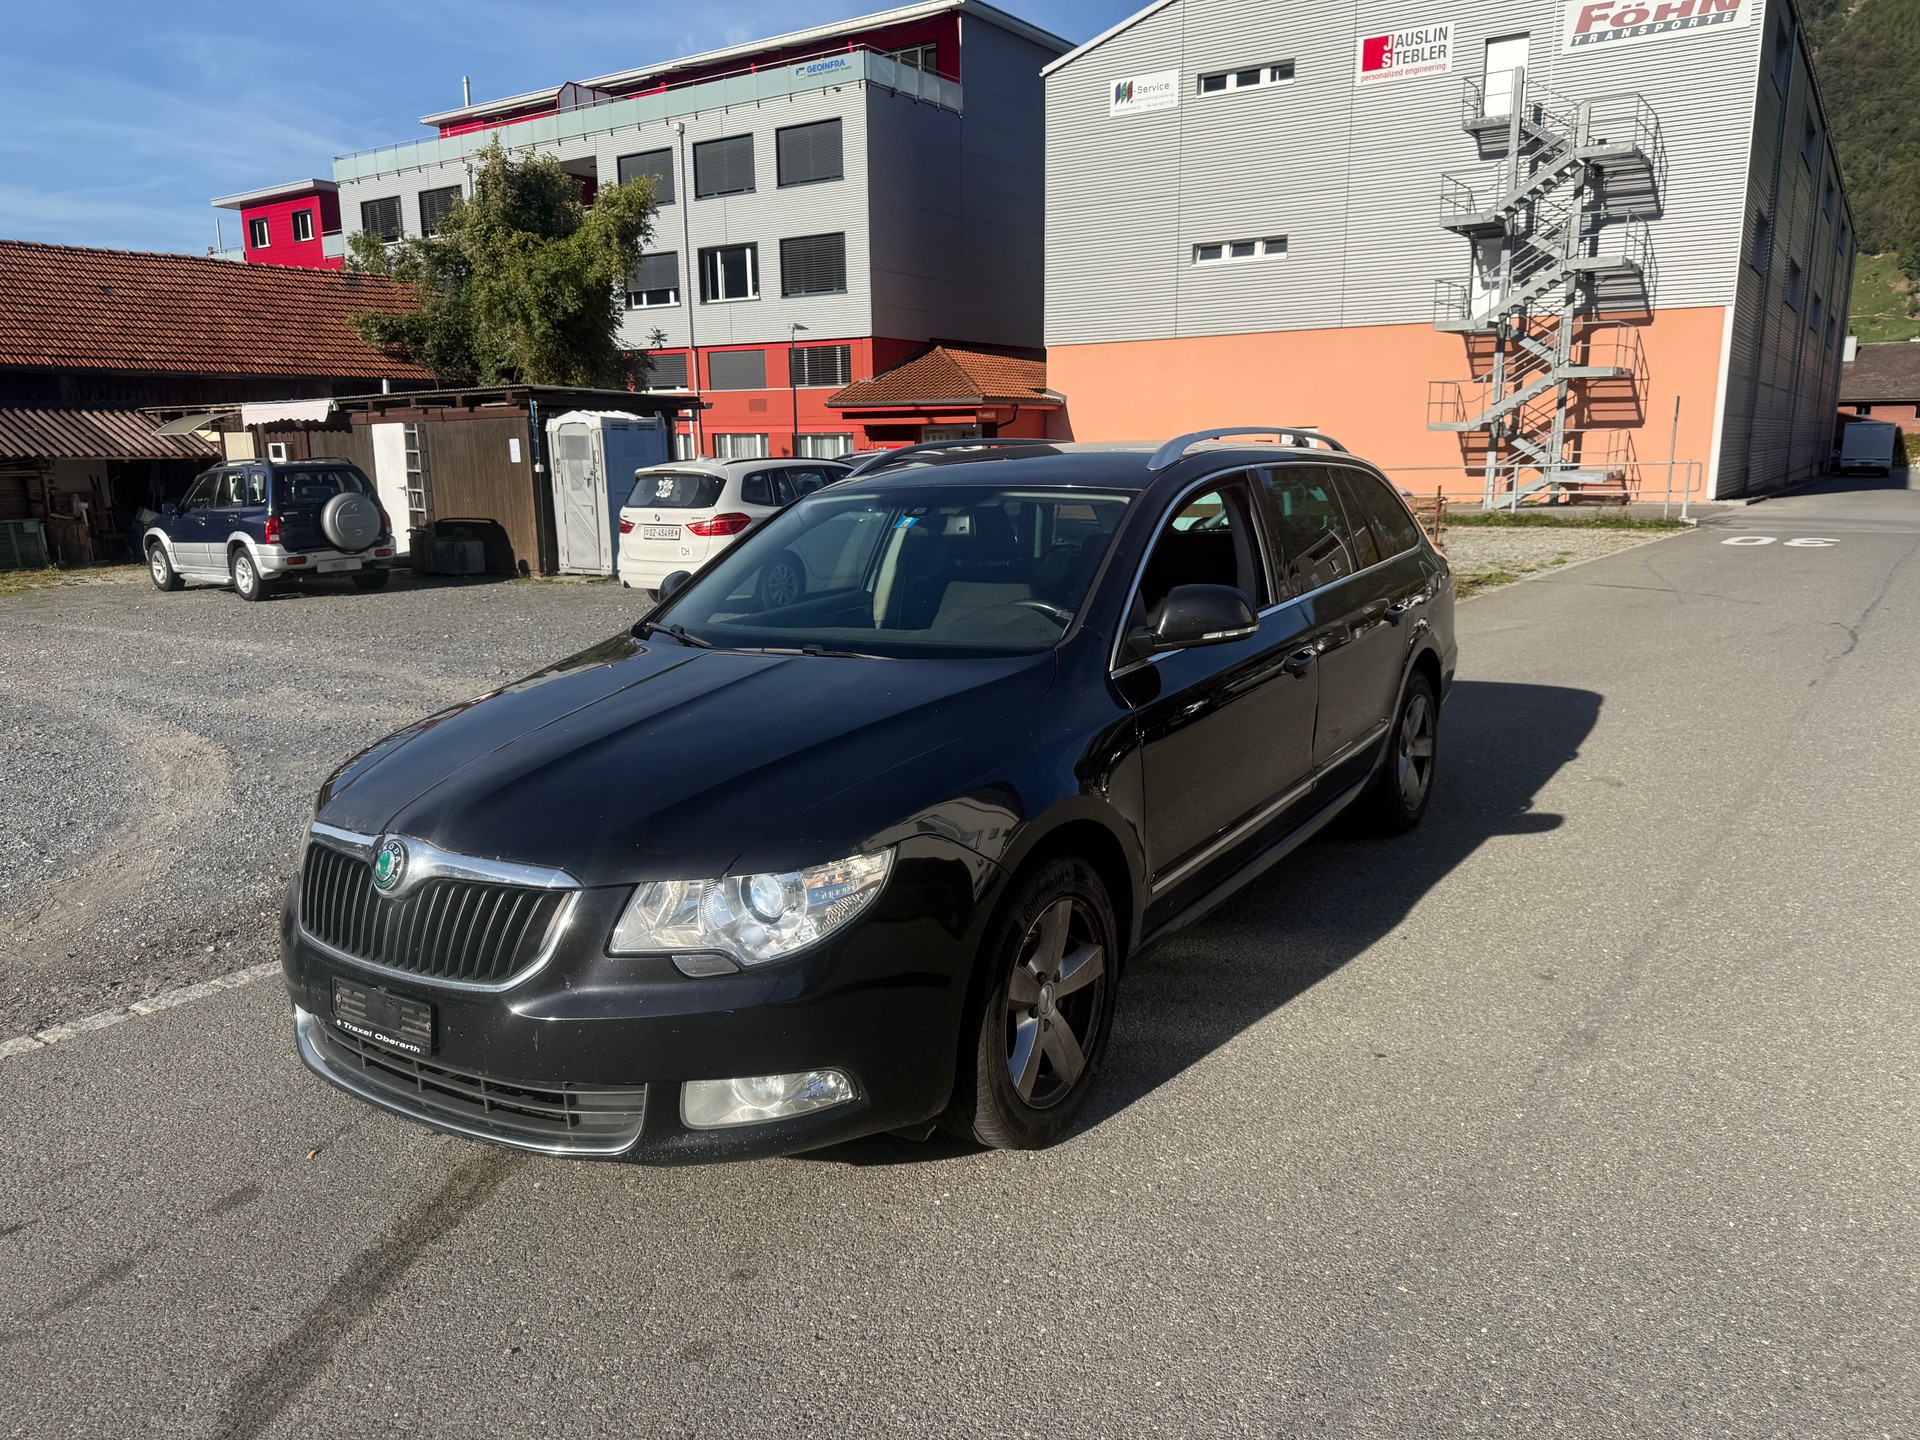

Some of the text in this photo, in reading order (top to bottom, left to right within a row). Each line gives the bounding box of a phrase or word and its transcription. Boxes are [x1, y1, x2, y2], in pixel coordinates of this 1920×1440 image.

[1383, 26, 1448, 51] JAUSLIN
[1573, 13, 1734, 44] TRANSPORTE
[806, 59, 846, 73] GEOINFRA
[1381, 44, 1447, 68] STEBLER
[1360, 63, 1446, 83] personalized engineering
[681, 547, 690, 556] CH
[1720, 535, 1841, 547] 30
[343, 1021, 421, 1053] Traxel Oberarth
